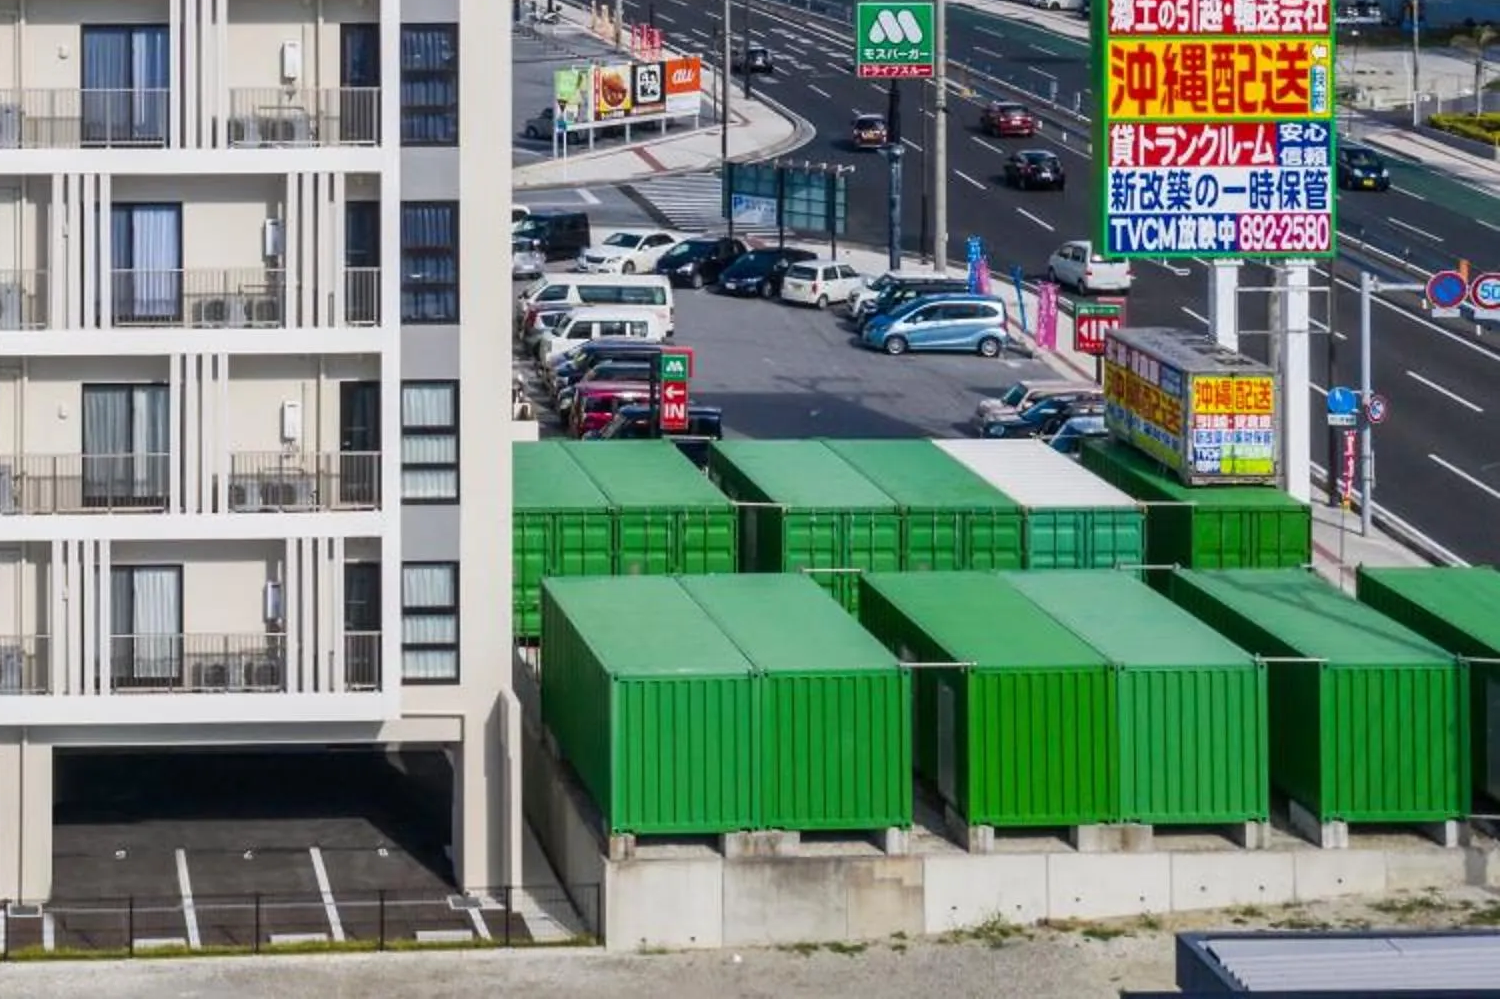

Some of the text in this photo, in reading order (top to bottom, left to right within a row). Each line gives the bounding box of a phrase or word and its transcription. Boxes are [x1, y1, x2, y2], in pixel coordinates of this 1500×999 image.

[863, 48, 929, 60] モスバーガー
[1111, 42, 1309, 116] 沖縄配送
[1111, 123, 1275, 166] 貸トランクルーム
[1279, 123, 1328, 142] 安心
[1279, 147, 1328, 166] 信頼
[1111, 169, 1329, 211] 新改築の一時保管
[1110, 214, 1329, 251] TVCM放映中 892-2580
[1195, 380, 1271, 410] 沖縄配送
[664, 403, 685, 419] IN
